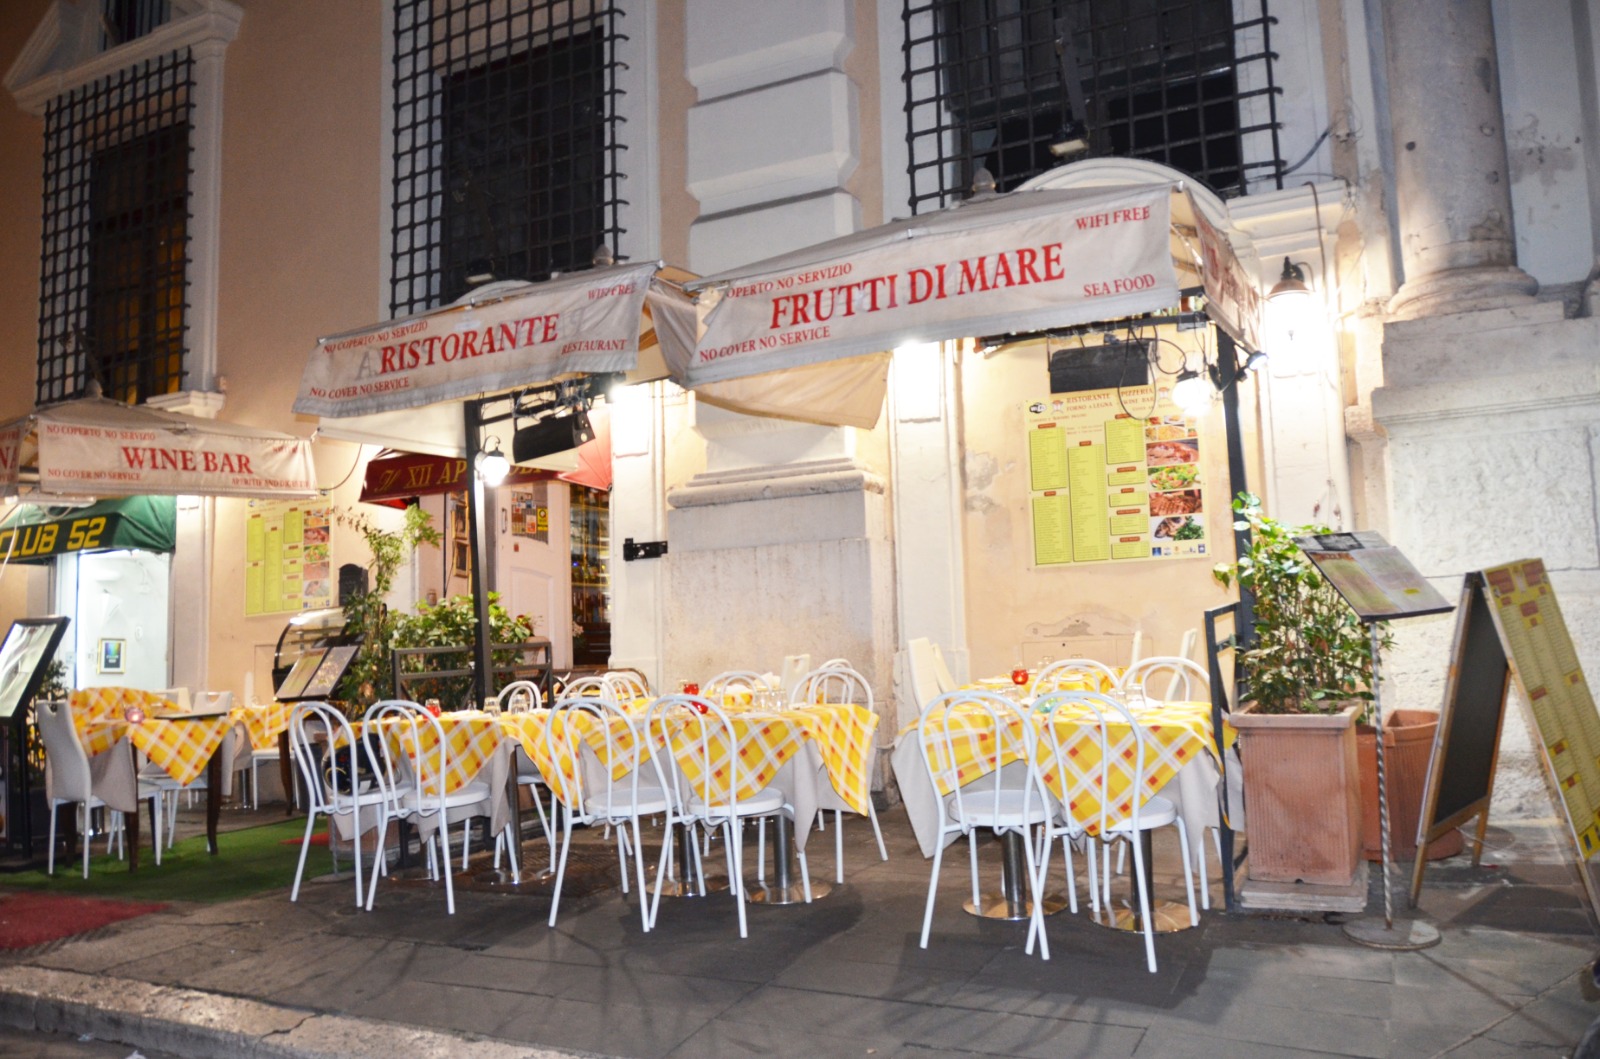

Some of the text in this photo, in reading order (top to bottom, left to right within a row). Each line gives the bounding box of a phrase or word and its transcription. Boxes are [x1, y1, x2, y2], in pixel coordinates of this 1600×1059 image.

[1075, 205, 1151, 230] WIFI FREE
[726, 263, 852, 298] OPERTO NO SERVIZIO
[770, 242, 1066, 330] FRUTTI DI MARE
[1083, 273, 1156, 298] SEA FOOD
[377, 332, 389, 342] NO
[391, 320, 428, 338] SERVIZIO
[379, 313, 560, 375] RISTORANTE
[561, 338, 628, 355] RESTAURANT
[699, 326, 831, 363] NO COVER NO SERVICE
[309, 376, 410, 400] NO COVER NO SERVICE
[46, 424, 156, 441] NO COPERTO NO SERVIZIO
[121, 446, 254, 474] WINE BAR
[48, 467, 142, 481] NO COVER NO SERVICE
[0, 516, 107, 559] CLUB 52
